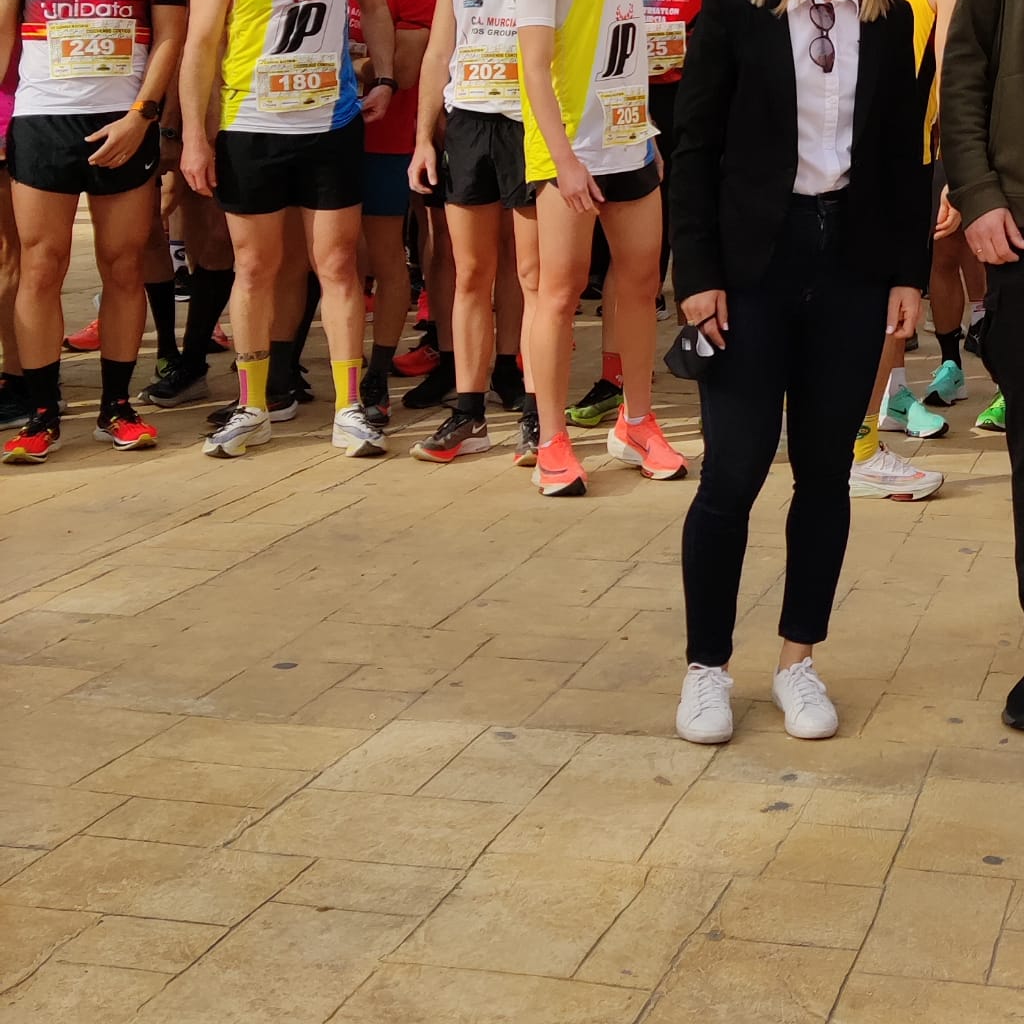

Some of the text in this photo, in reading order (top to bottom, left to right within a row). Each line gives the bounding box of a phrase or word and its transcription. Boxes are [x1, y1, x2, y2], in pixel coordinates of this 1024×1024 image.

[69, 38, 116, 57] 249
[646, 40, 668, 57] 25
[468, 63, 507, 81] 202
[278, 73, 321, 92] 180
[617, 106, 640, 125] 205
